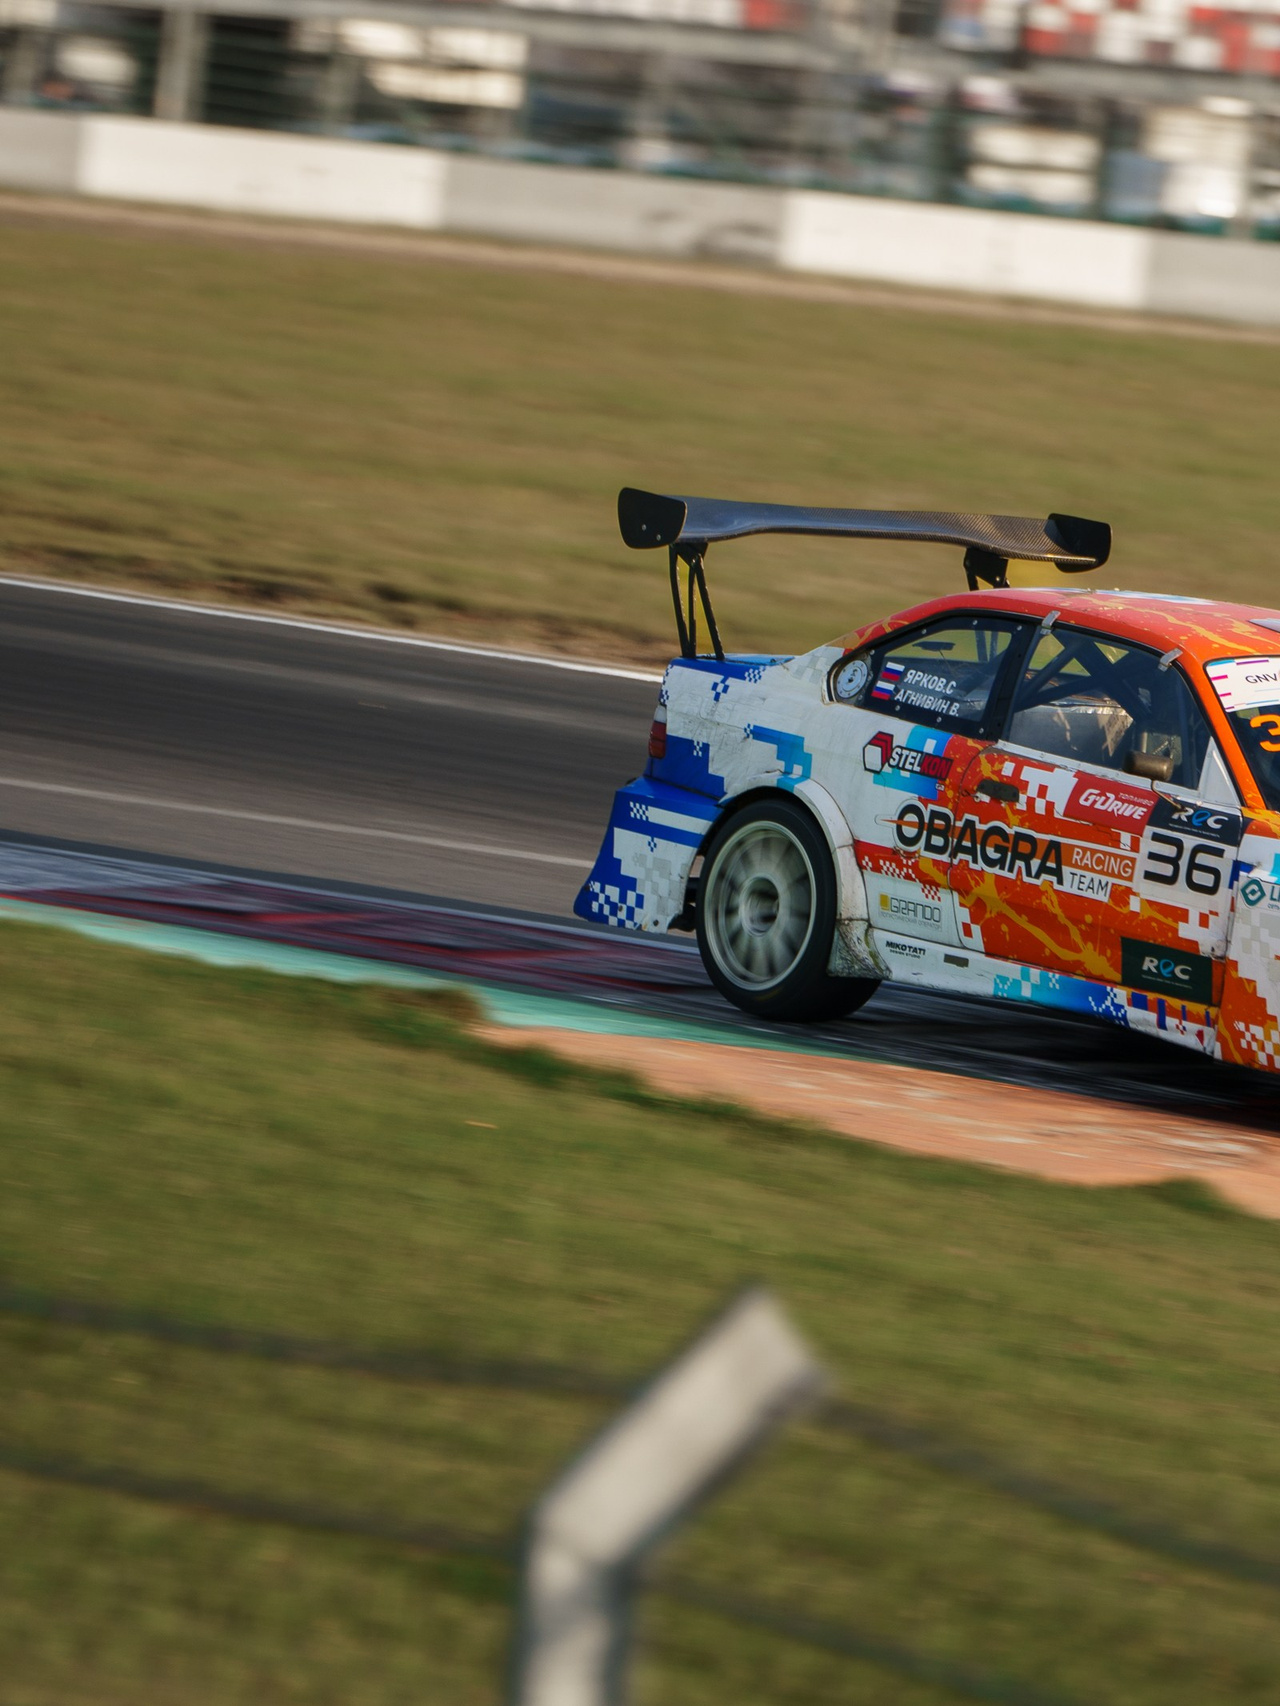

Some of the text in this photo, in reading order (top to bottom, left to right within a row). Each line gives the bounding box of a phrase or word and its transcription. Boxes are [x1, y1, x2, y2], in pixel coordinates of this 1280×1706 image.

[1245, 673, 1278, 684] GNV
[894, 688, 960, 717] АГНИВИН В.
[889, 747, 952, 779] STELKON
[895, 803, 1064, 886] OBAGRA
[1072, 847, 1133, 877] RACING
[1143, 831, 1225, 896] 36
[1069, 871, 1110, 897] TEAM
[890, 896, 941, 923] GRANDO
[885, 940, 926, 956] MIKOTATI
